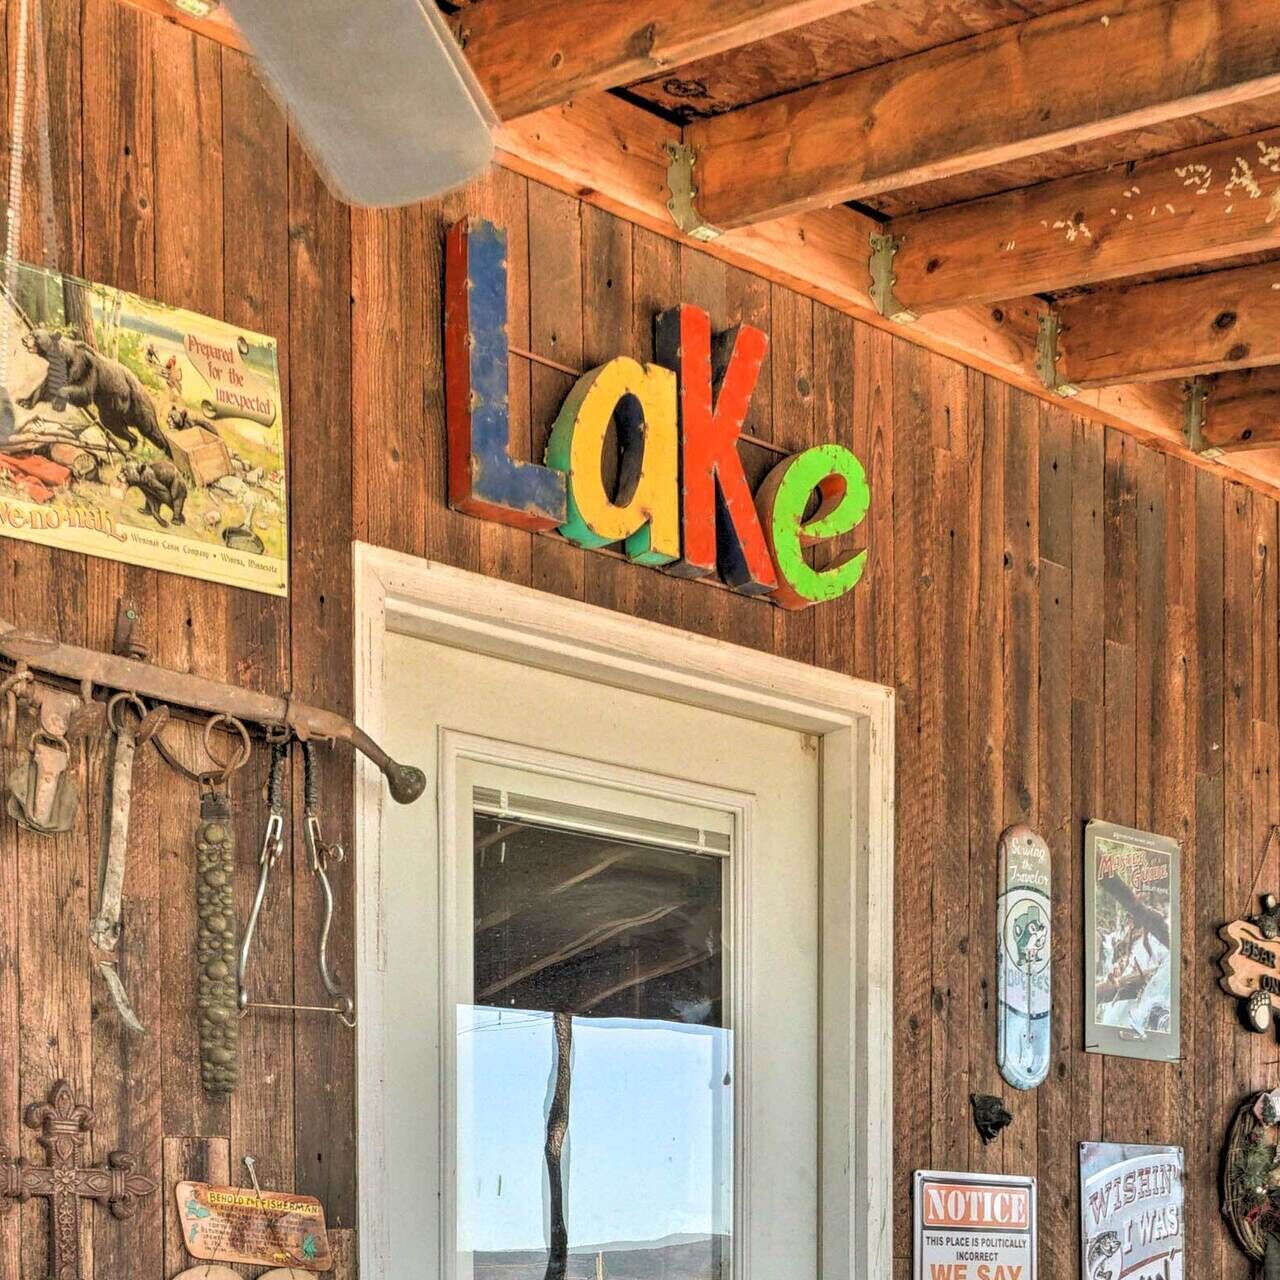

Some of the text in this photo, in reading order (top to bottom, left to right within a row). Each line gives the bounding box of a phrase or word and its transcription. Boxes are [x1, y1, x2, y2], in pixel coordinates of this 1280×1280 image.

[188, 333, 235, 364] Prepared
[208, 361, 244, 387] for the
[210, 1193, 244, 1205] BEHOLD
[262, 1201, 319, 1213] FISHERMAN
[928, 1189, 1025, 1223] NOTICE
[926, 1236, 1027, 1248] THIS PLACE IS POLITICALLY
[1123, 1205, 1179, 1254] I WAS
[956, 1251, 998, 1261] INCORRECT
